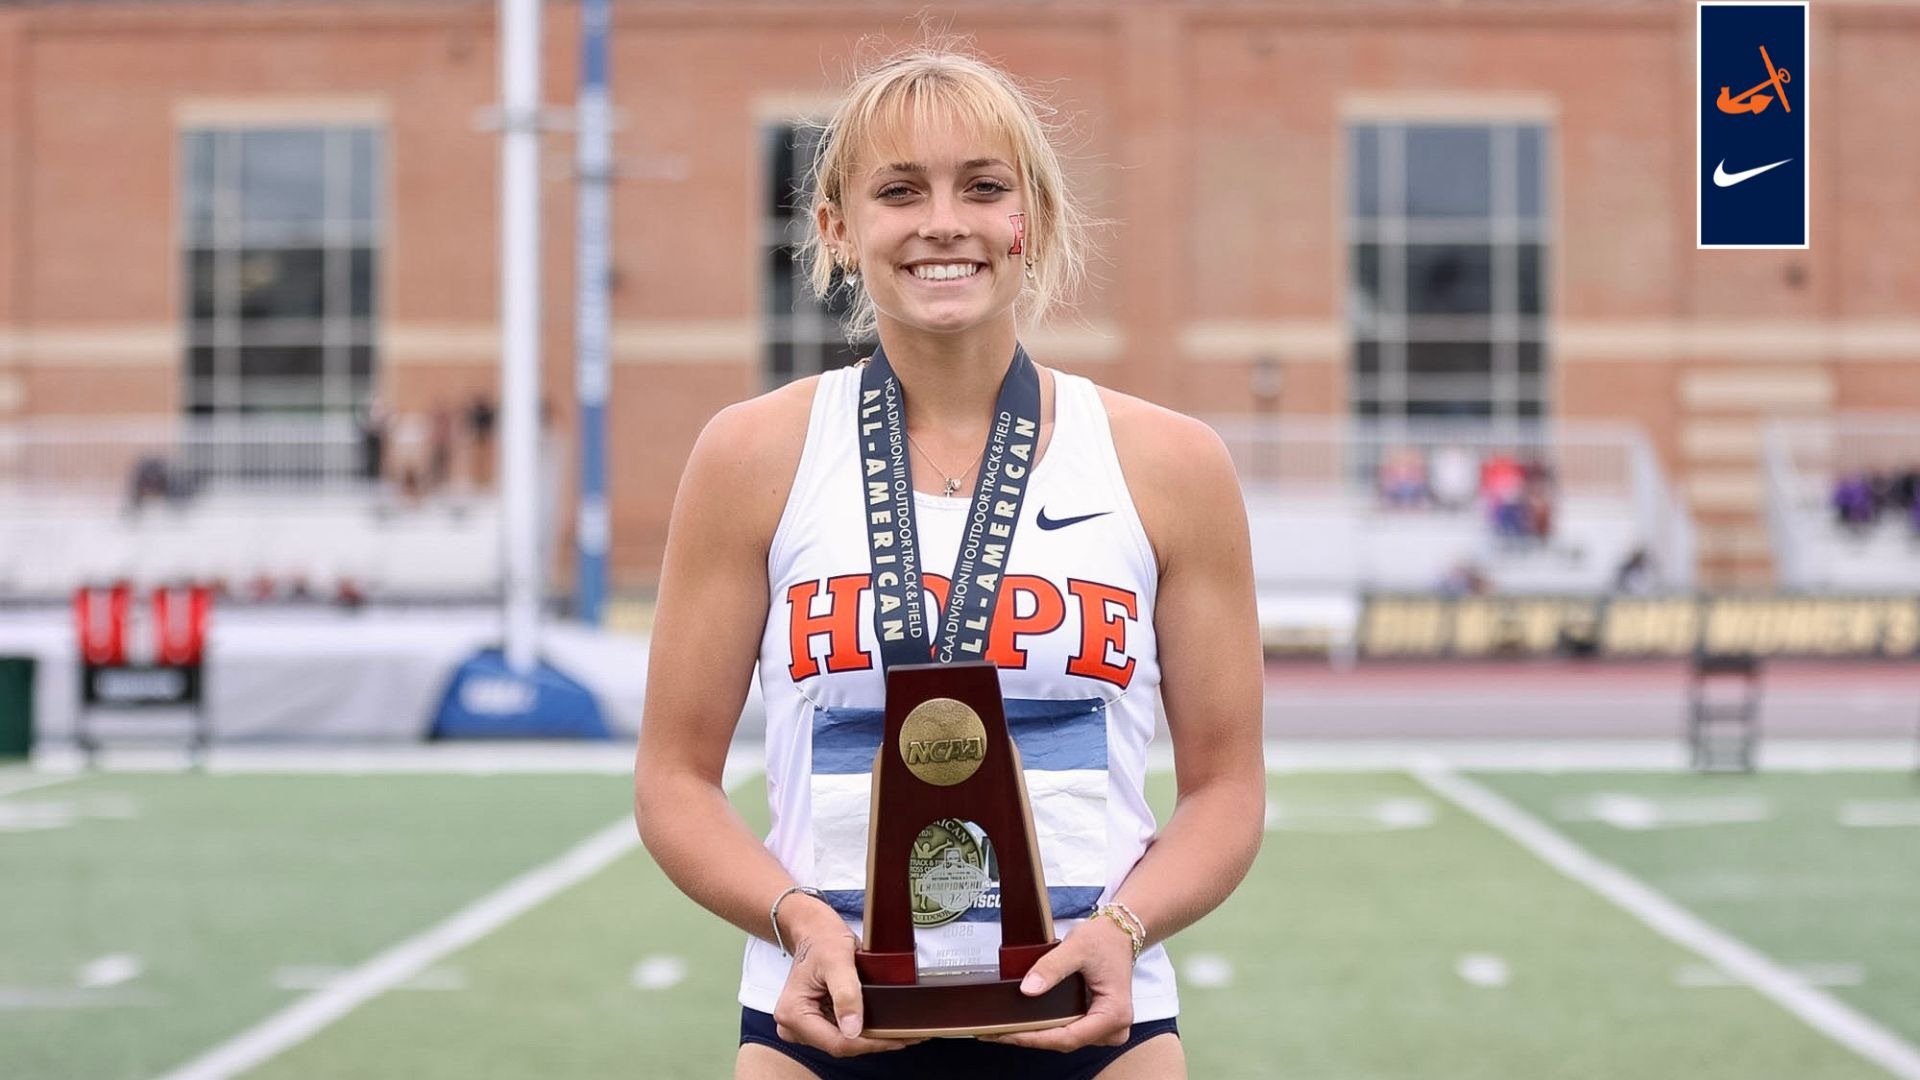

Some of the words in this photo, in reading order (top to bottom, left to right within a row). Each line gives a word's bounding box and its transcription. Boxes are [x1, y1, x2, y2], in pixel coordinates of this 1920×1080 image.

[884, 377, 897, 412] NCAA
[887, 411, 904, 466] DIVISION
[994, 411, 1012, 444] FIELD
[893, 467, 906, 479] III
[981, 454, 1002, 493] TRACK
[862, 388, 904, 641] ALL-AMERICAN
[894, 479, 912, 547] OUTDOOR
[964, 494, 992, 560] OUTDOOR
[961, 417, 1036, 653] LL-AMERICAN
[902, 548, 918, 591] TRACK
[961, 561, 974, 573] III
[907, 602, 922, 639] FIELD
[946, 573, 970, 633] DIVISION
[787, 573, 1138, 690] HPE
[940, 635, 957, 664] CAA
[908, 737, 983, 765] NCAA
